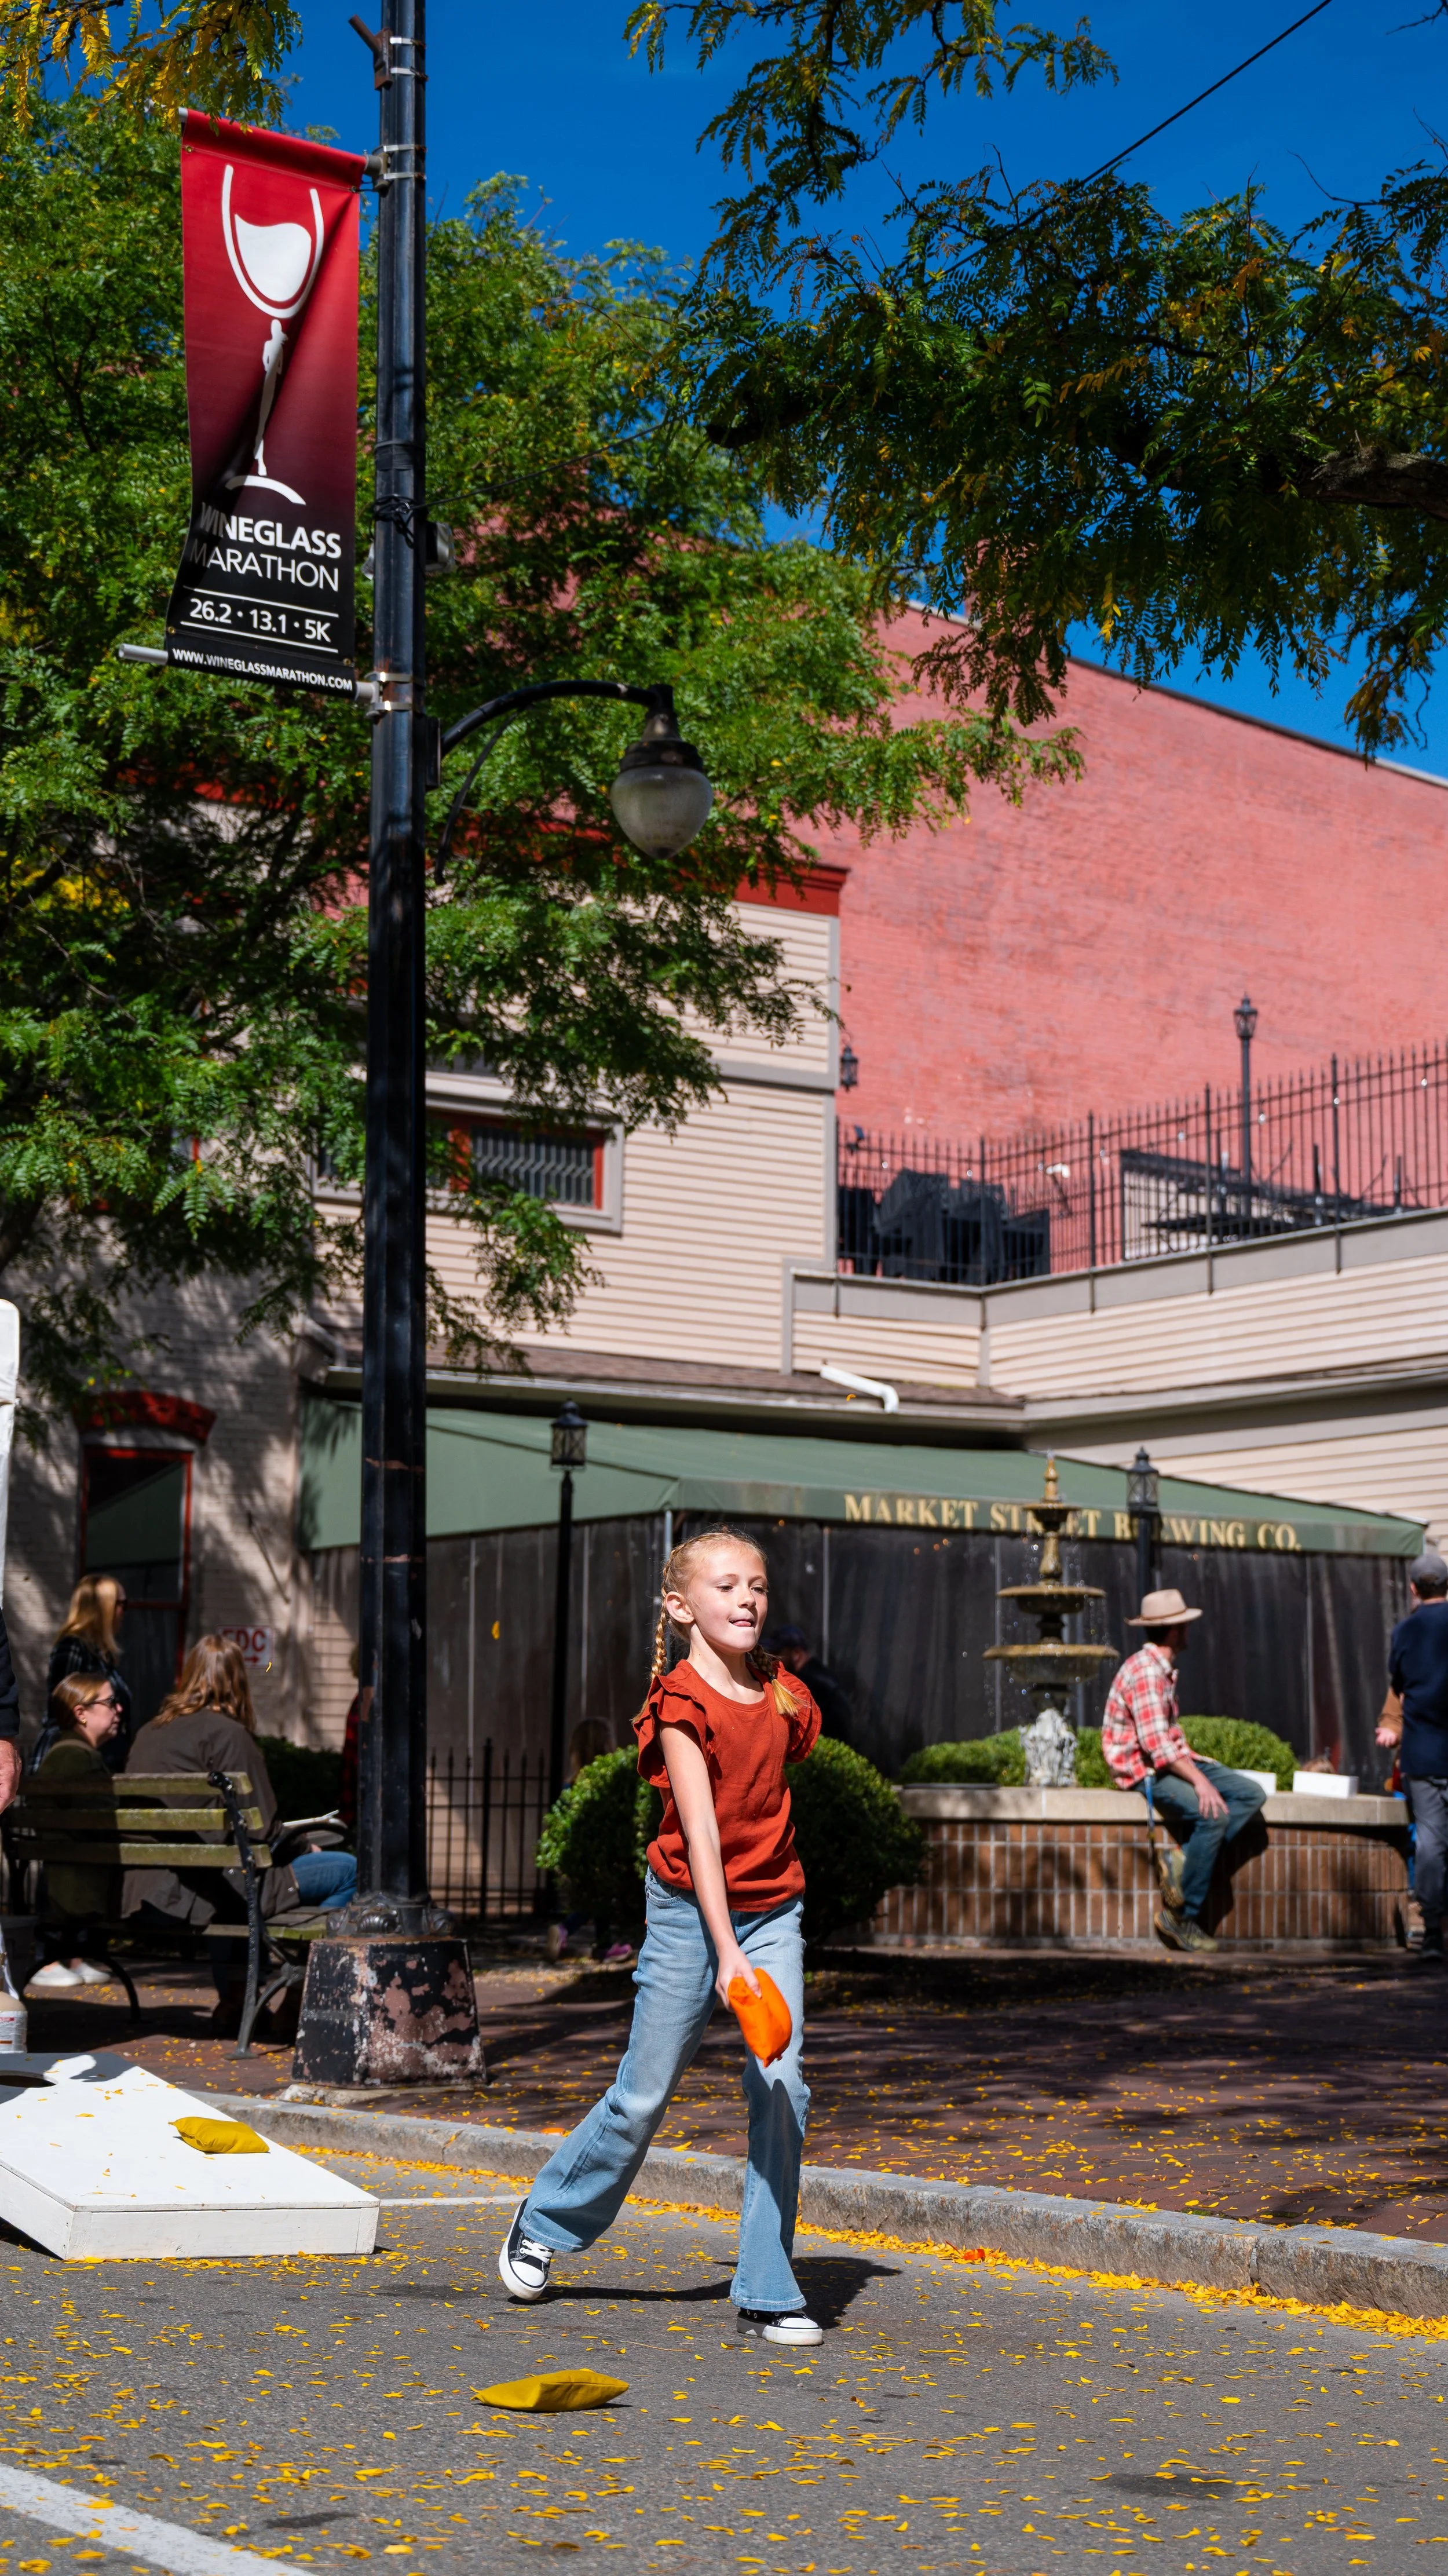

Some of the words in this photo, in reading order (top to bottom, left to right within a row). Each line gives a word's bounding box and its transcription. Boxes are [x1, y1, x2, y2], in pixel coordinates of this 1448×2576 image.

[200, 502, 342, 559] WINEGLASS
[189, 538, 339, 592] MARATHON
[189, 598, 232, 624] 26.2
[249, 609, 287, 634] 13.1
[304, 619, 331, 642] 5K
[172, 648, 353, 691] WWW.WINEGLASSMARATHON.COM
[844, 1494, 979, 1529] MARKET
[1257, 1522, 1302, 1551] CO.
